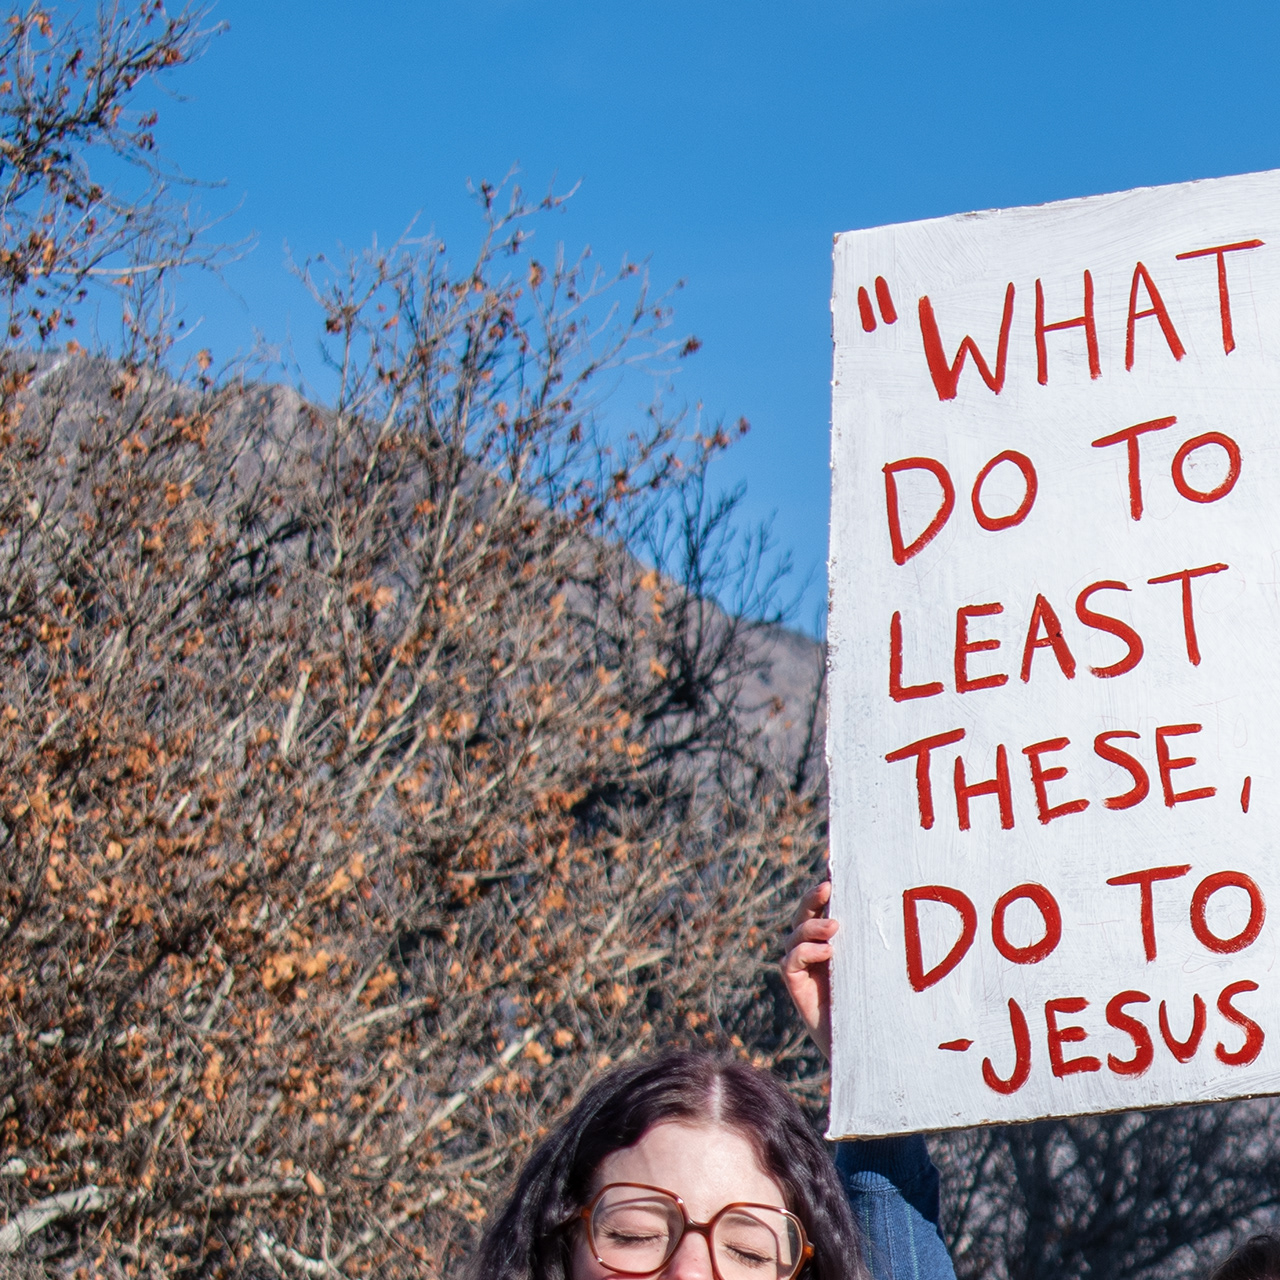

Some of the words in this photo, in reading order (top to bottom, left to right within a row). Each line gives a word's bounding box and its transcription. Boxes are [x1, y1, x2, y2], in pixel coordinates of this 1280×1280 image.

[857, 239, 1263, 401] "WHAT
[882, 450, 1038, 565] DO
[1091, 415, 1242, 521] TO
[889, 563, 1228, 702] LEAST
[885, 723, 1251, 829] THESE,
[902, 883, 1062, 992] DO
[1106, 864, 1266, 961] TO
[939, 980, 1265, 1095] -JESUS
